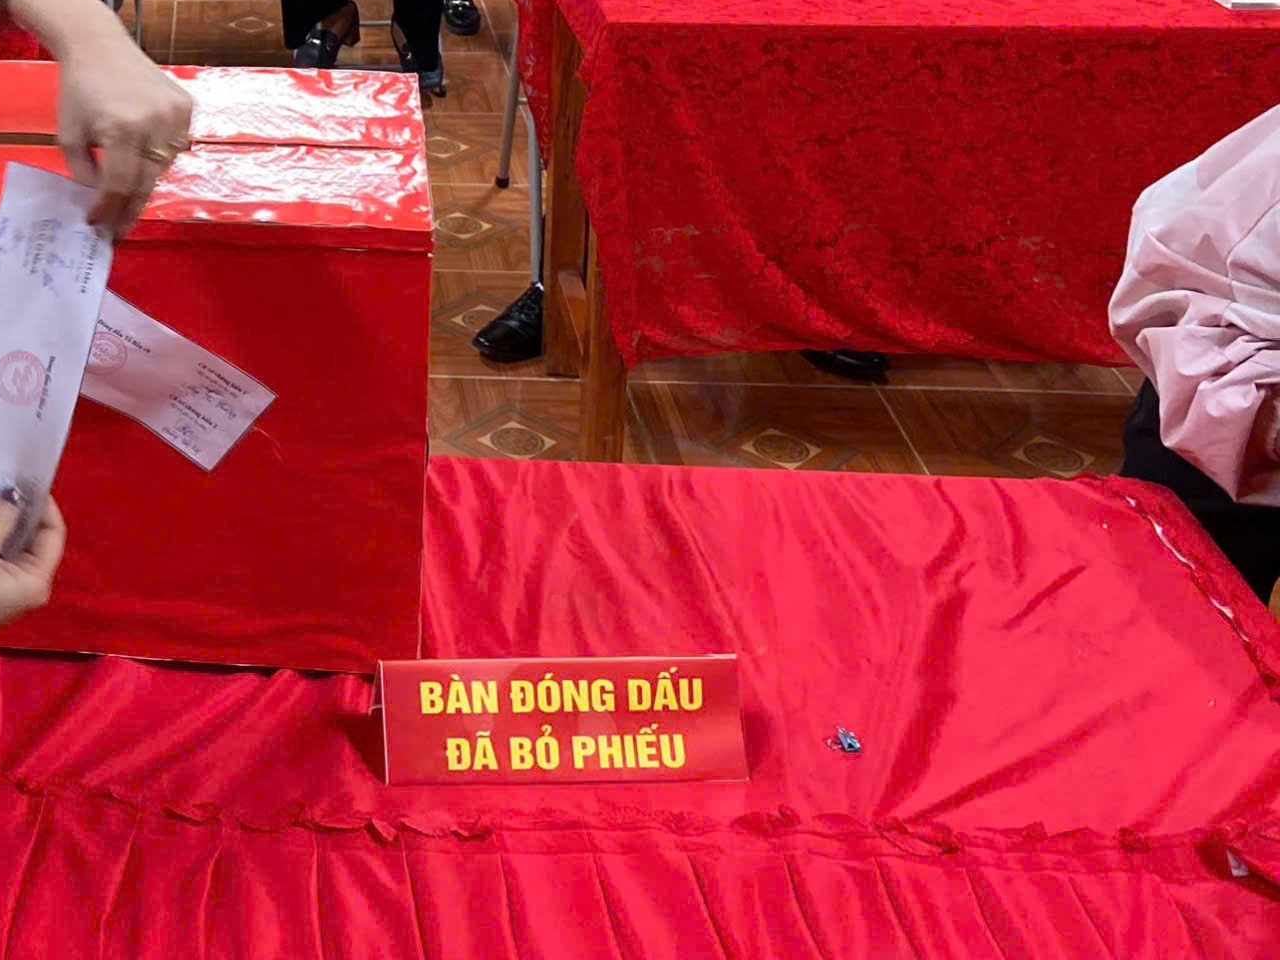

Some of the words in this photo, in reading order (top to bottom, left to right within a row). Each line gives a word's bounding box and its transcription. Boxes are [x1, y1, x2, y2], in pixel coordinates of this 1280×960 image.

[420, 674, 499, 714] BÀN
[510, 672, 615, 713] ĐÓNG
[627, 667, 704, 711] DẤU
[446, 730, 498, 771] ĐÃ
[510, 725, 560, 770] BỎ
[573, 723, 686, 770] PHIẾU
